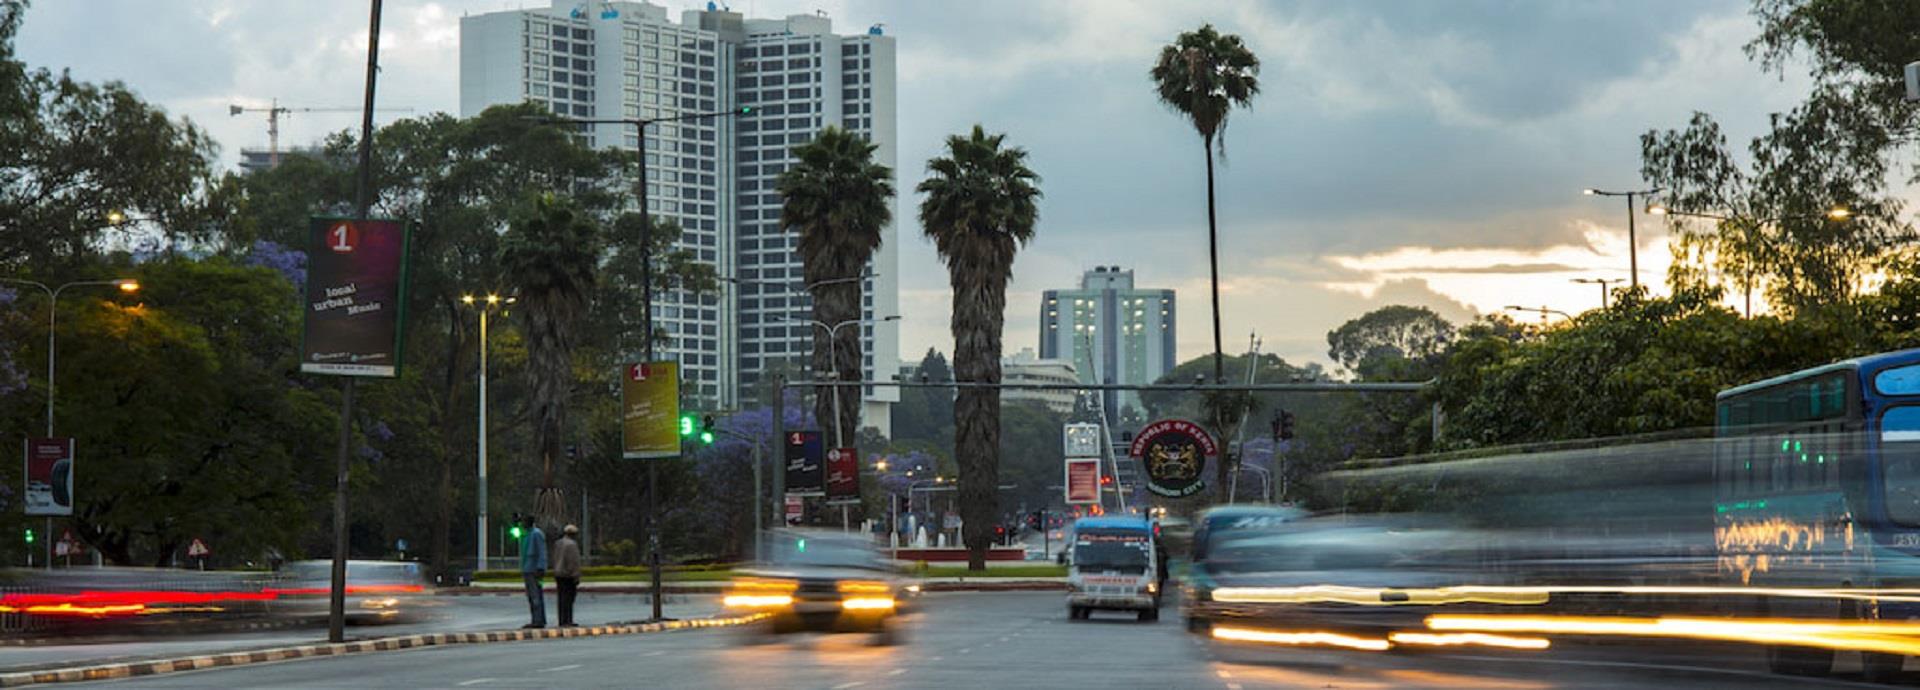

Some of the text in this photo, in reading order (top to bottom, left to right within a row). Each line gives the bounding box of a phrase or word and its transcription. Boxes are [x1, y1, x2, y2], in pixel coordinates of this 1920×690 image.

[333, 225, 352, 251] 1
[325, 283, 357, 297] local
[313, 297, 353, 311] urban
[634, 363, 646, 380] 1
[791, 433, 803, 445] 1
[1133, 422, 1213, 455] REPUBLIC OF KENYA
[1183, 480, 1202, 495] CITY
